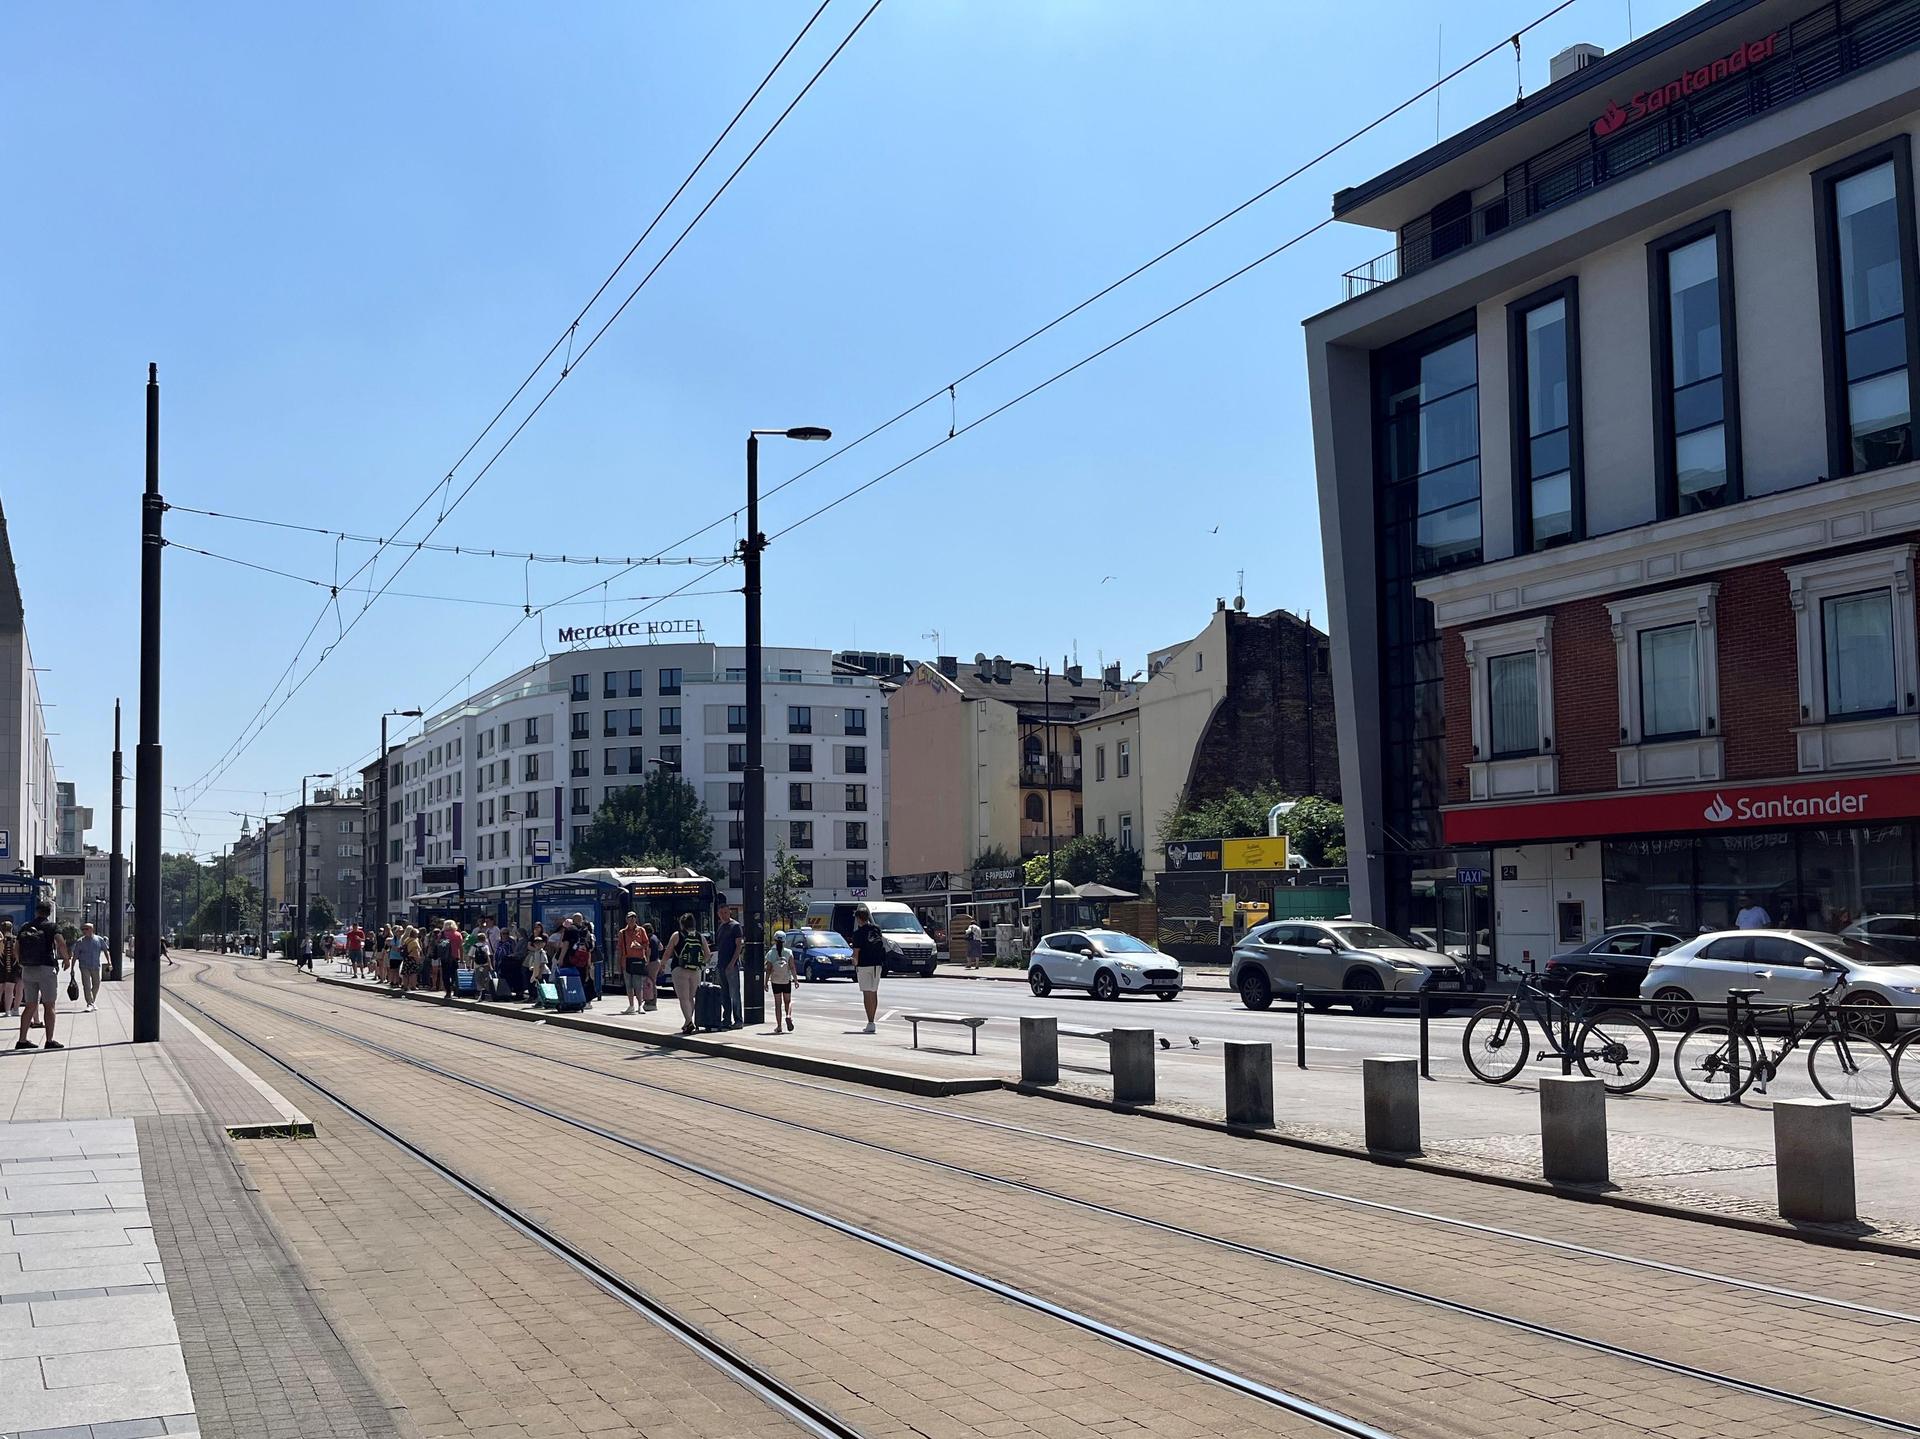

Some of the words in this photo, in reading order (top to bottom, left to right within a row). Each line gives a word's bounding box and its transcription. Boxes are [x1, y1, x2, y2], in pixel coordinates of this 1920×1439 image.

[1631, 32, 1780, 118] Santander
[558, 622, 640, 643] Mercure
[649, 619, 704, 633] HOTEL
[1737, 791, 1868, 820] Santander
[985, 869, 1016, 881] E-PAPIEROSY
[1459, 871, 1481, 883] TAXI
[1503, 867, 1515, 877] 24
